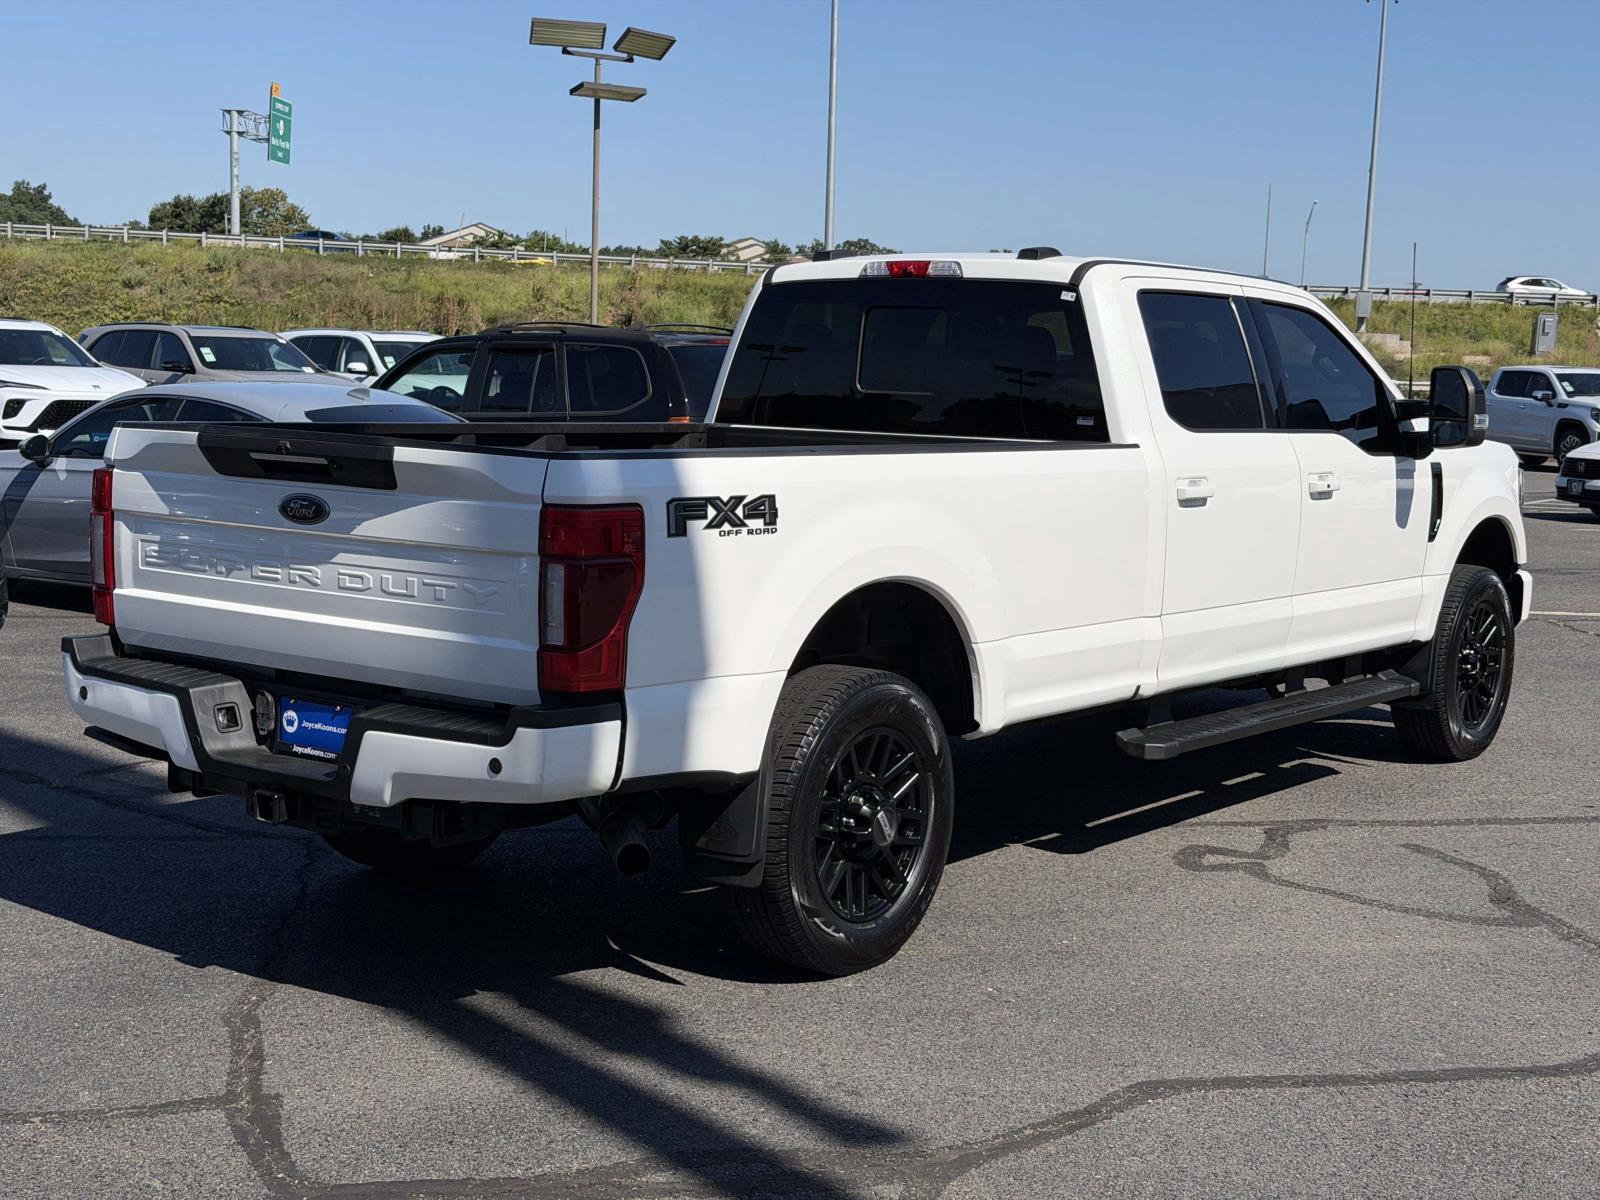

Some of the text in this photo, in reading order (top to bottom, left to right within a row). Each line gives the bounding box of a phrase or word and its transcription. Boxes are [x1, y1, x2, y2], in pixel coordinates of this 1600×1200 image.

[287, 499, 316, 518] Ford
[666, 494, 778, 538] FX4
[718, 527, 778, 538] OFF ROAD
[337, 568, 500, 606] DUTY
[292, 744, 336, 759] JoyceKoons.com
